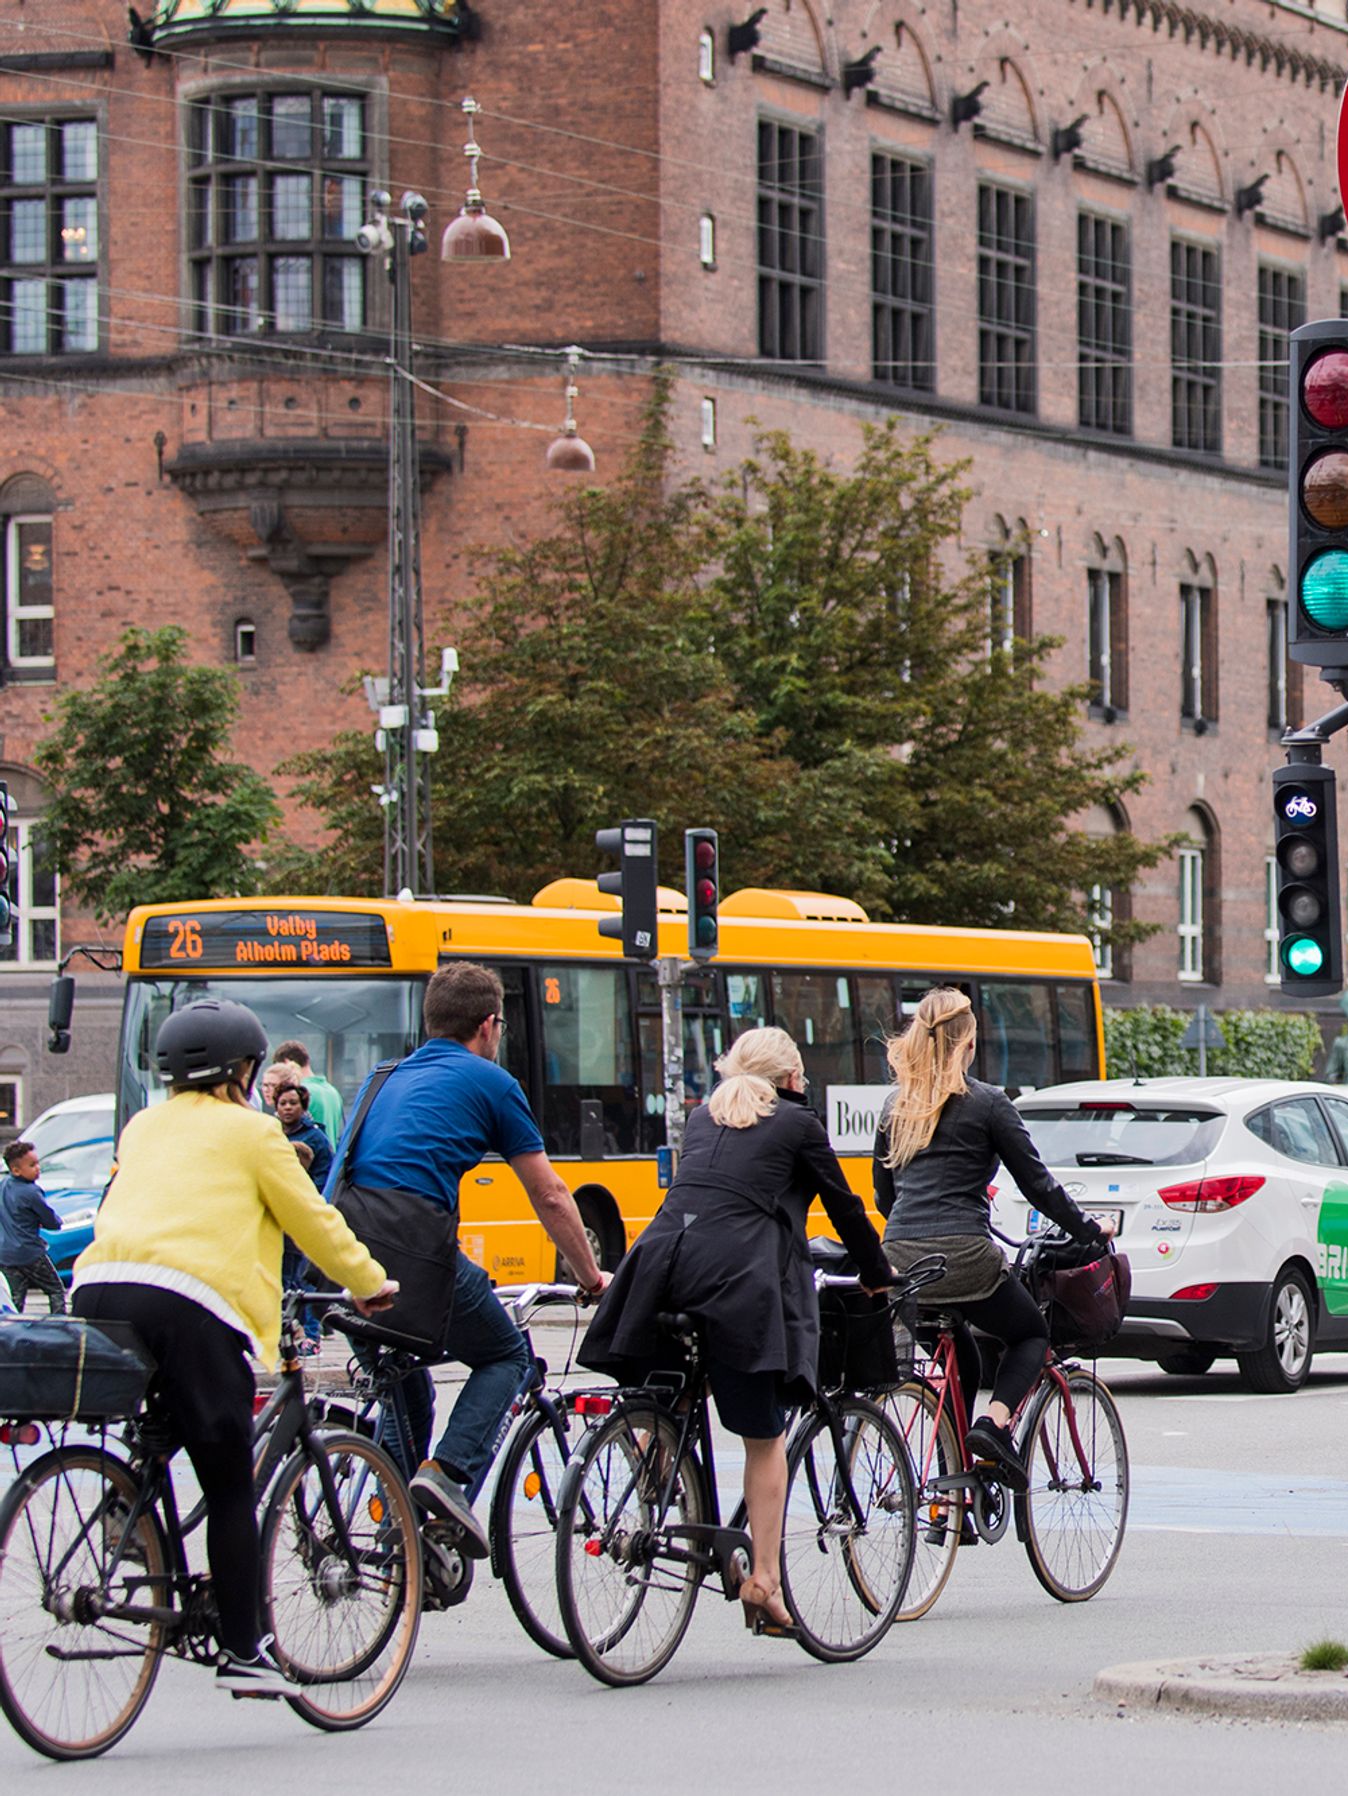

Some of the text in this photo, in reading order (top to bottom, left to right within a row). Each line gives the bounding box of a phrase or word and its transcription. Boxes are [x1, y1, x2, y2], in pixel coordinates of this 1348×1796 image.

[266, 915, 317, 939] Valby
[168, 920, 203, 959] 26
[301, 940, 351, 961] Plads
[544, 977, 561, 1005] 26
[501, 1256, 525, 1267] ARRIVA
